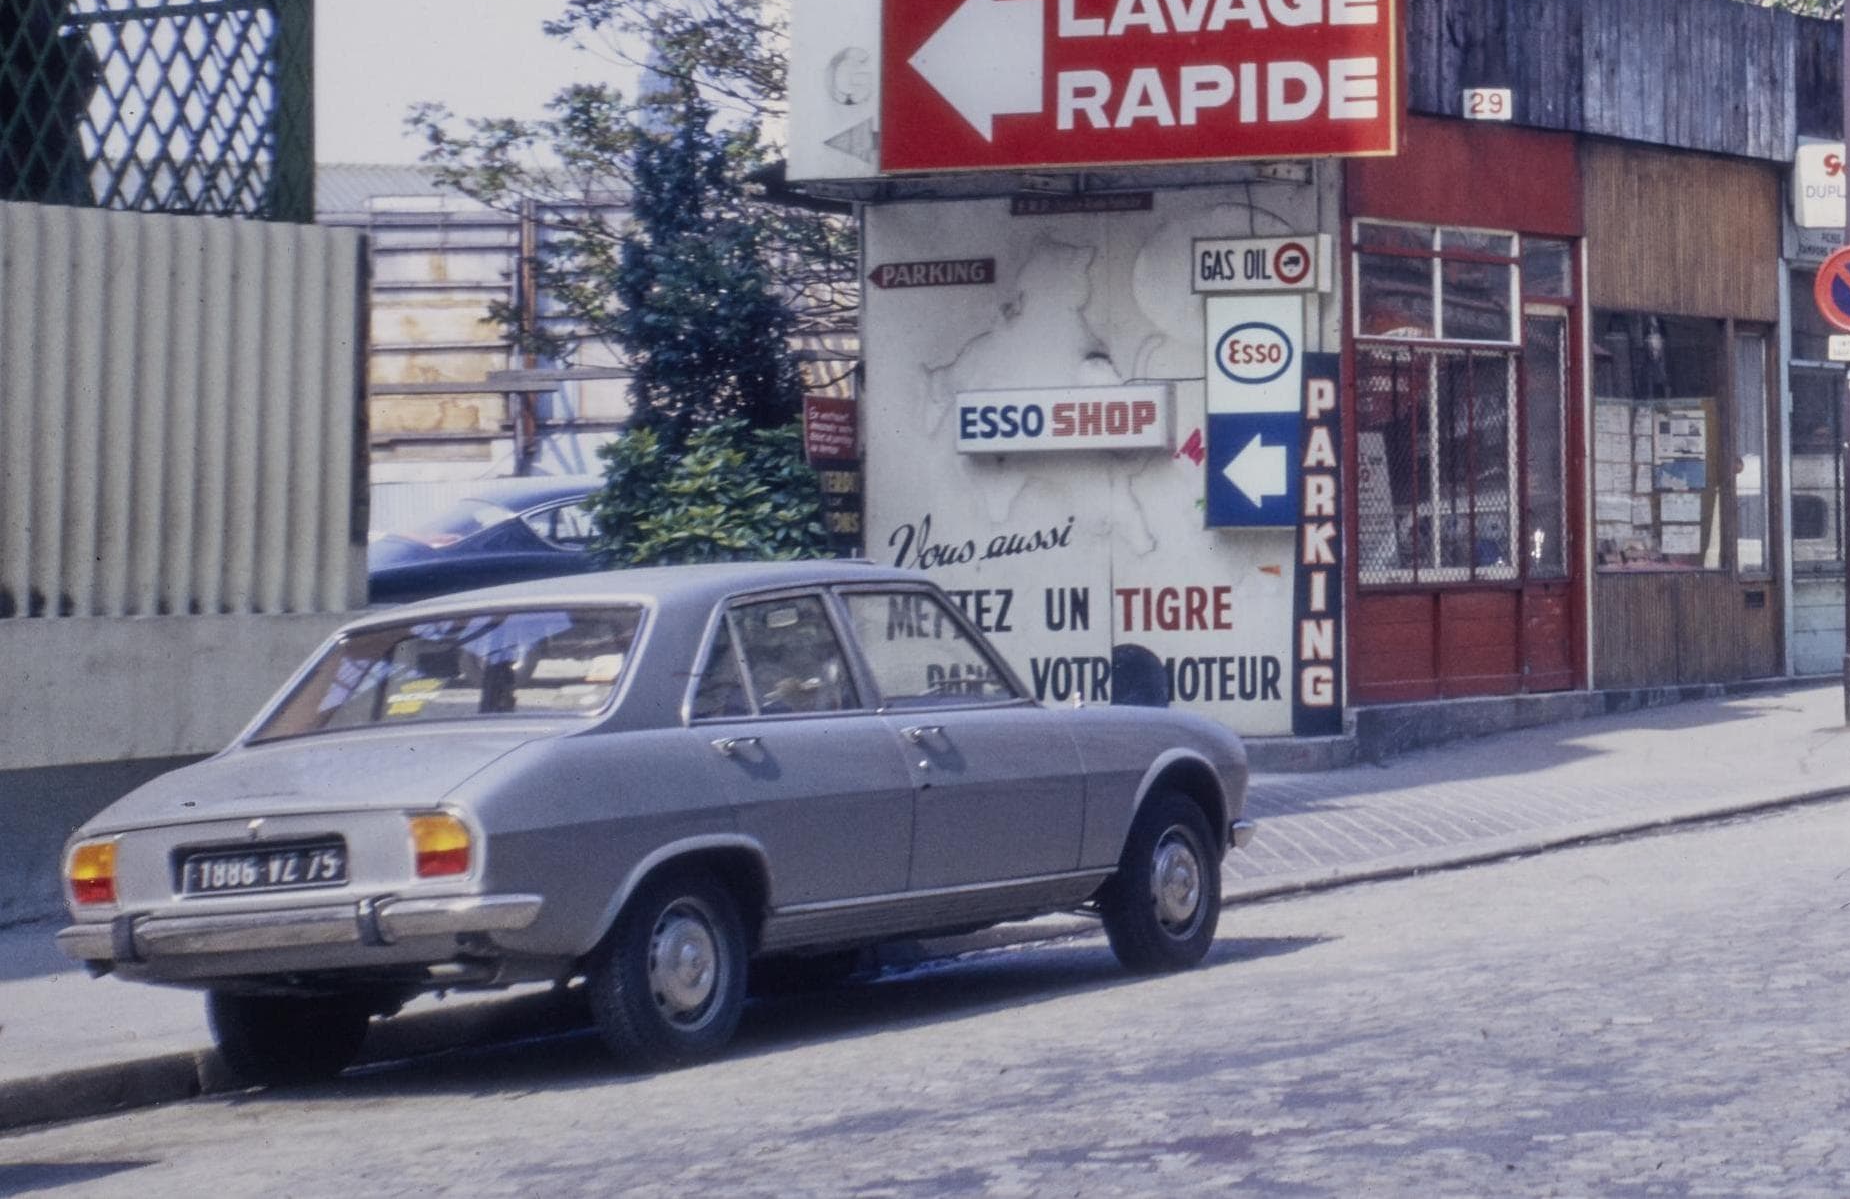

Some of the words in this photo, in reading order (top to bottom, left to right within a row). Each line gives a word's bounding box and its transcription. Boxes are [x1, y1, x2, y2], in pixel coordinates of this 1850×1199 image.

[1057, 57, 1377, 130] RAPIDE
[1470, 92, 1503, 114] 29
[882, 262, 985, 286] PARKING
[1201, 250, 1235, 281] GAS
[1244, 249, 1272, 280] OIL
[960, 404, 1044, 440] ESSO
[1052, 401, 1157, 437] SHOP
[888, 513, 975, 569] Vous
[978, 515, 1075, 562] aussi
[1301, 378, 1337, 706] PARKING
[1045, 587, 1090, 631] UN
[1115, 586, 1233, 632] TIGRE
[1030, 657, 1111, 701] VOTR
[306, 849, 341, 881] 75
